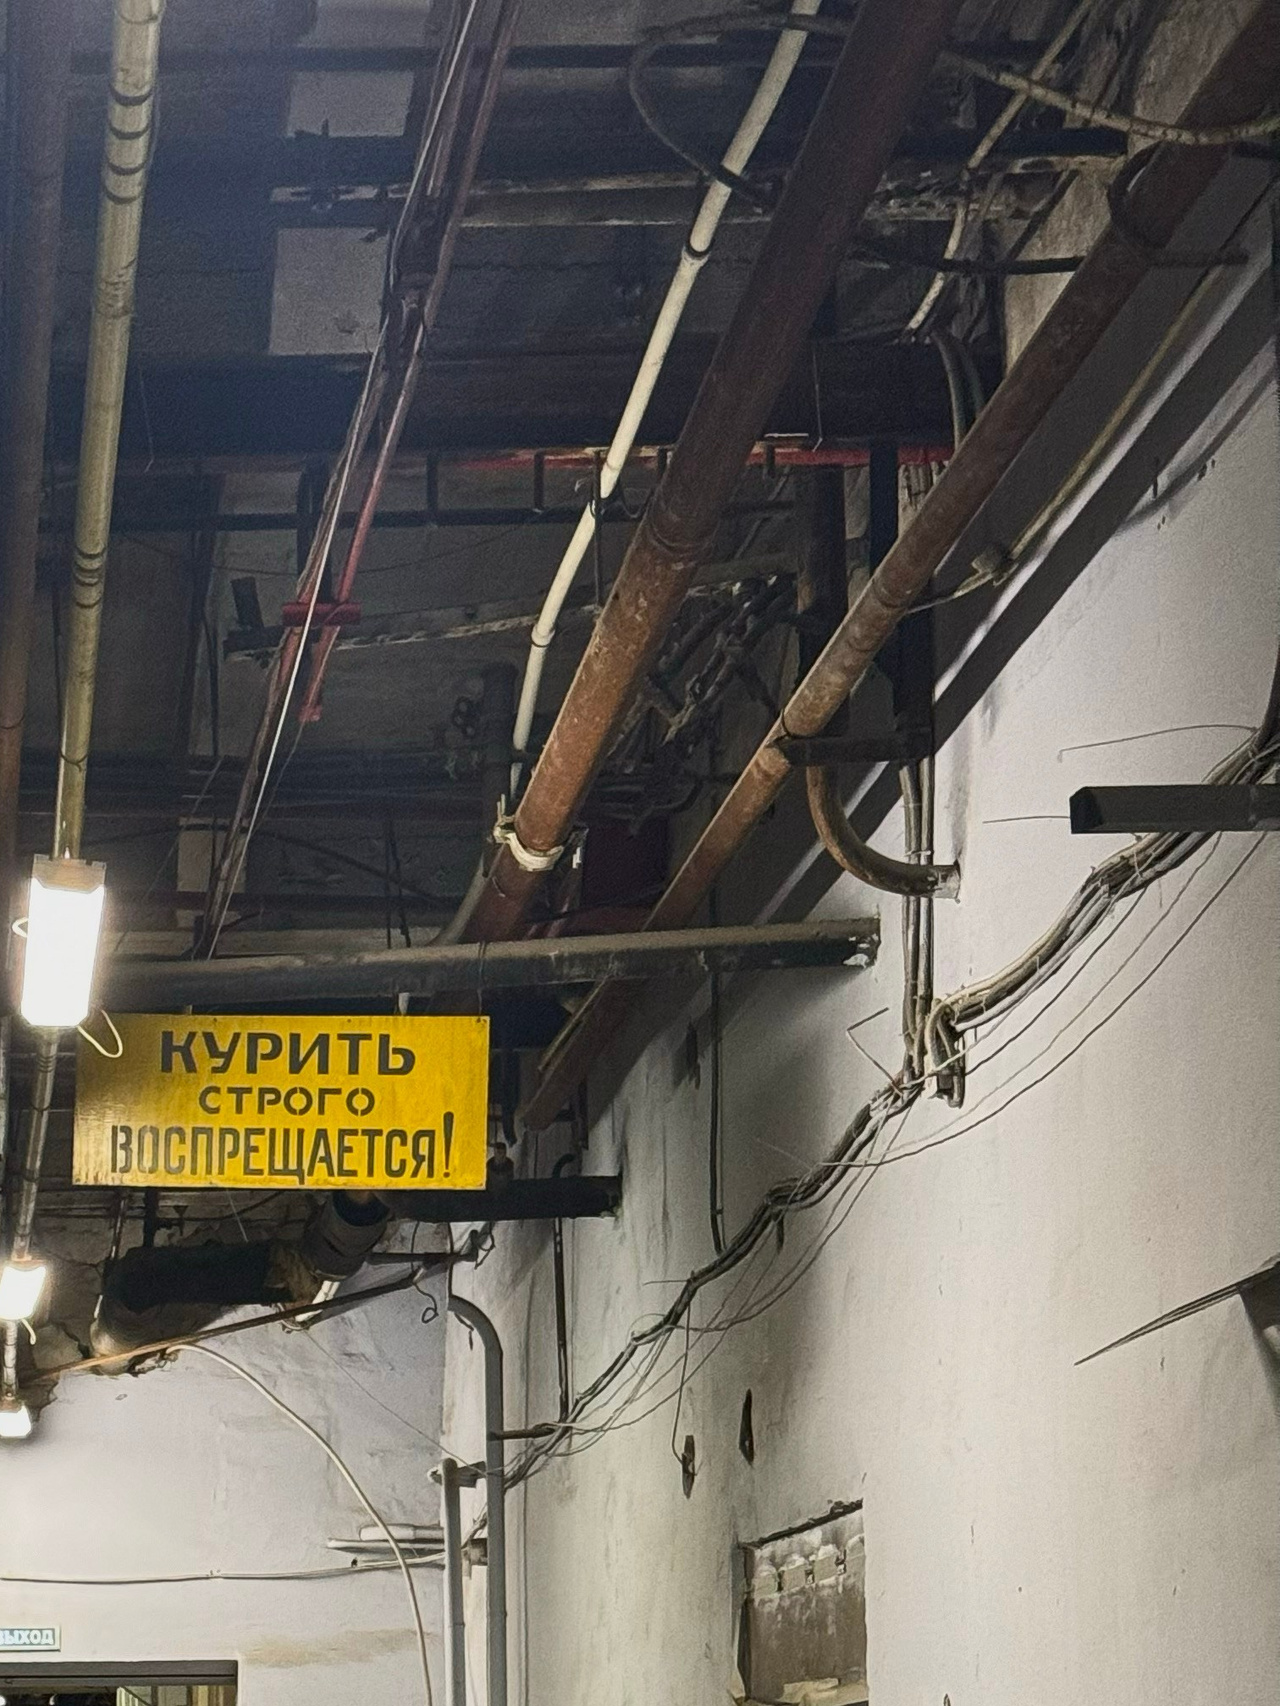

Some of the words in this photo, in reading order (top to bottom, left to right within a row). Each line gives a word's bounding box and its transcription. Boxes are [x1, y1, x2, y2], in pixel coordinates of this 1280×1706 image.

[160, 1030, 416, 1076] КУРИТЬ
[198, 1086, 376, 1117] СТРОГО
[110, 1111, 455, 1186] ВОСПРЕЩАЕТСЯ!
